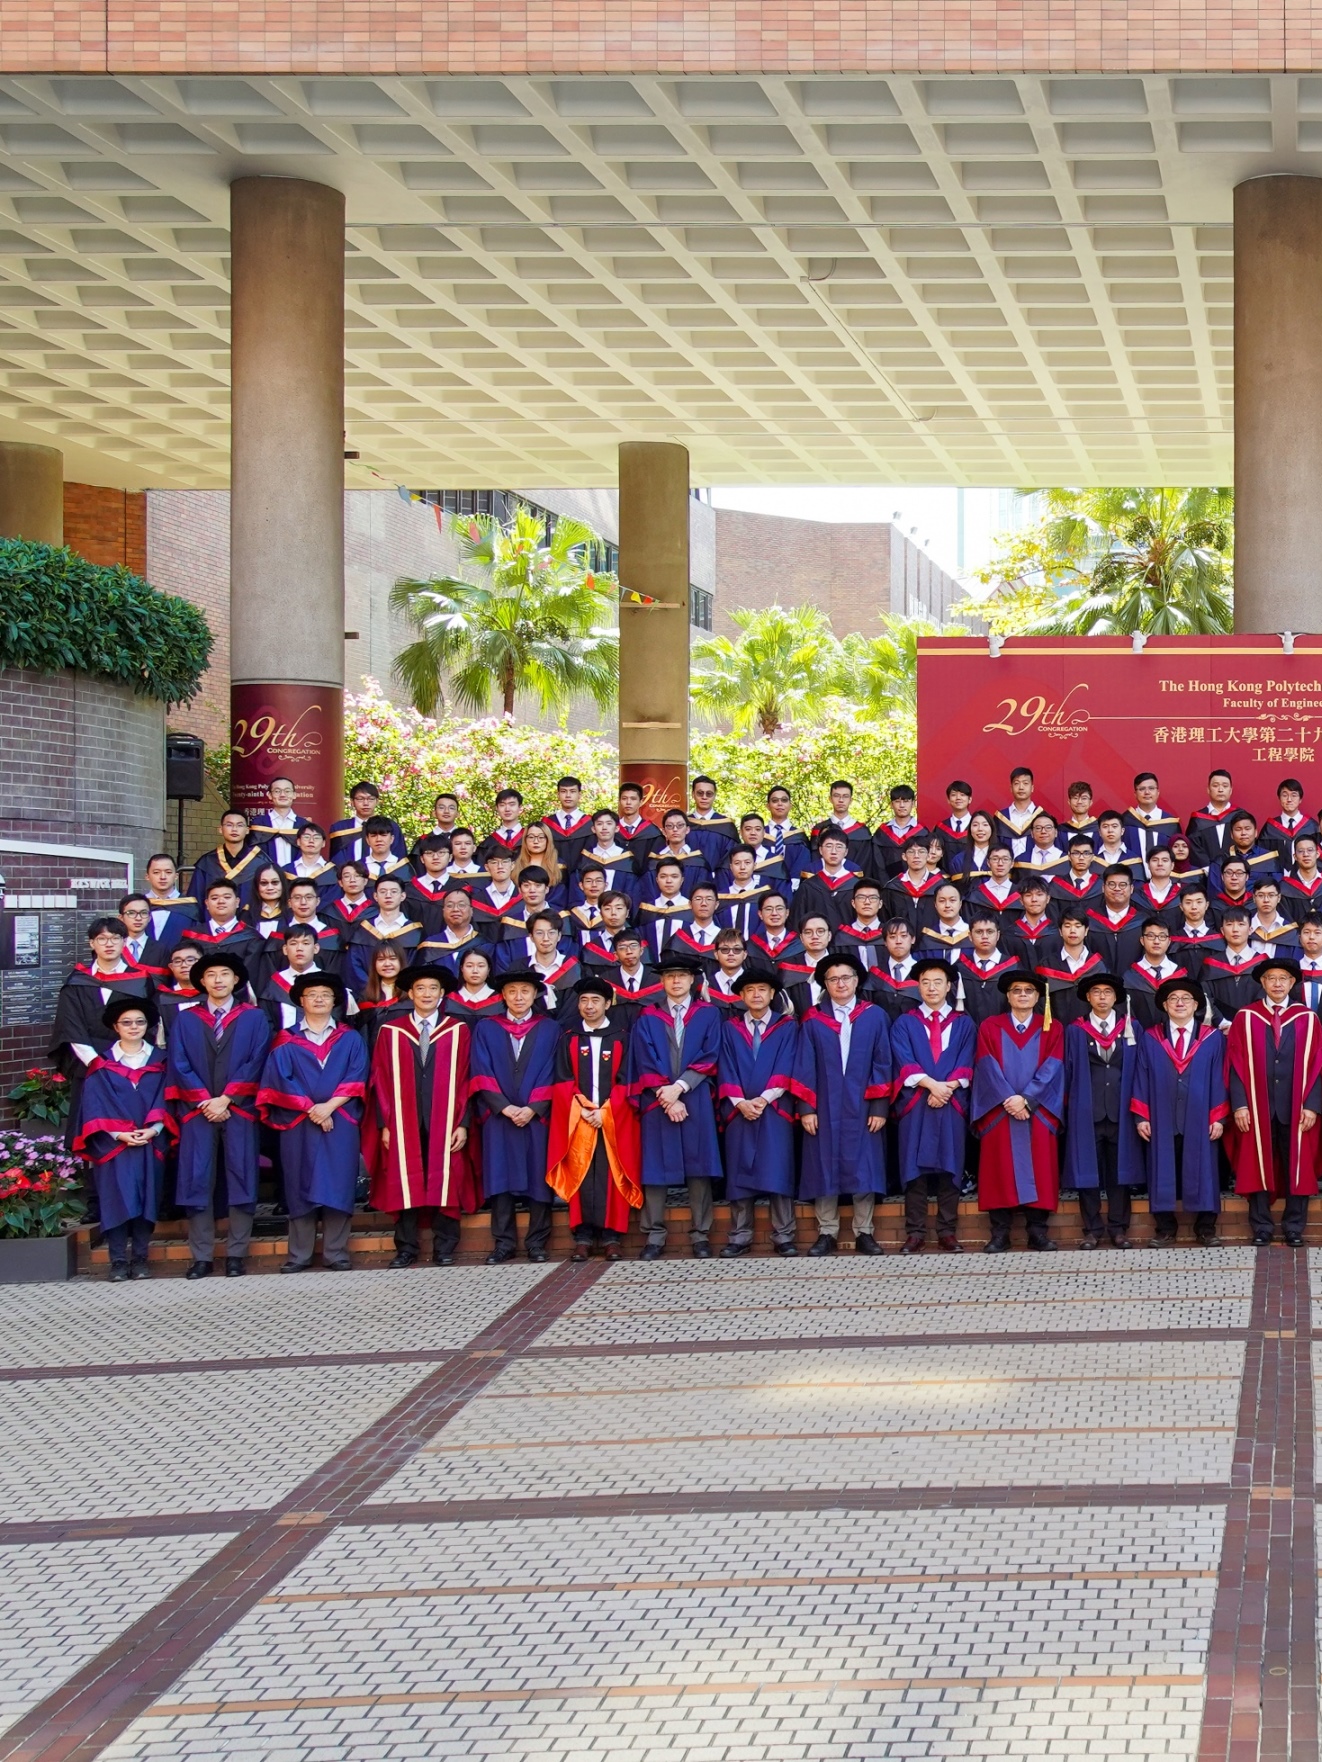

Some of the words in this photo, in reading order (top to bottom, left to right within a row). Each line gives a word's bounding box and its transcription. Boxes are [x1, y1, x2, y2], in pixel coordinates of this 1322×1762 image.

[1158, 679, 1184, 692] The
[1188, 679, 1224, 694] Hong
[1227, 679, 1263, 694] Kong
[982, 683, 1091, 736] 29th
[1222, 697, 1264, 709] Faculty
[1266, 697, 1279, 708] of
[232, 704, 323, 758] 29th
[1252, 747, 1315, 762] 工程學院
